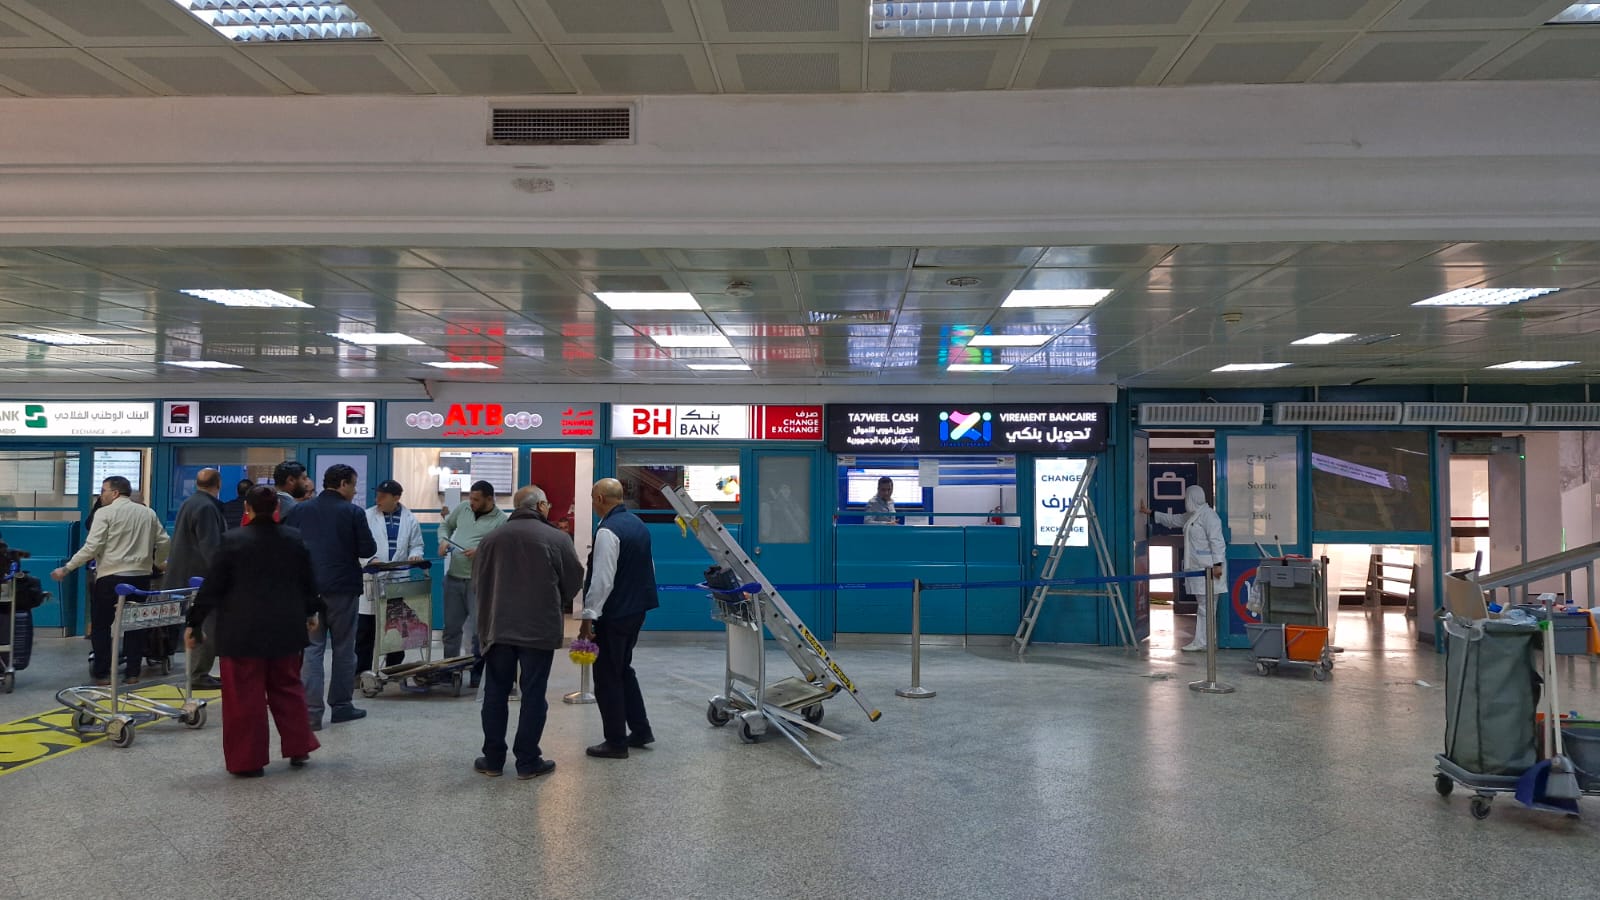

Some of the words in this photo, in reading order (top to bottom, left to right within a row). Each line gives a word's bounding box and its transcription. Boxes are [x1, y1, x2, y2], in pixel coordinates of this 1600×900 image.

[0, 410, 20, 422] NK
[54, 410, 89, 421] الفلاحي
[91, 410, 124, 422] الوطني
[126, 410, 149, 422] البنك
[204, 415, 254, 424] EXCHANGE
[259, 415, 298, 424] CHANGE
[302, 413, 333, 427] صرف
[445, 403, 503, 426] ATB
[680, 409, 720, 424] بنك
[795, 410, 819, 419] صرف
[848, 413, 890, 422] TA7WEEL
[891, 413, 919, 422] CASH
[999, 412, 1048, 422] VIREMENT
[1049, 412, 1098, 422] BANCAIRE
[633, 408, 672, 435] BH
[167, 426, 193, 434] UIB
[342, 426, 369, 435] UIB
[681, 424, 719, 436] BANK
[894, 425, 914, 435] تحويل
[1005, 426, 1043, 443] بنكي
[1046, 426, 1092, 443] تحويل
[1041, 474, 1081, 482] CHANGE
[1247, 481, 1277, 490] Sortie
[1252, 511, 1272, 520] Exit
